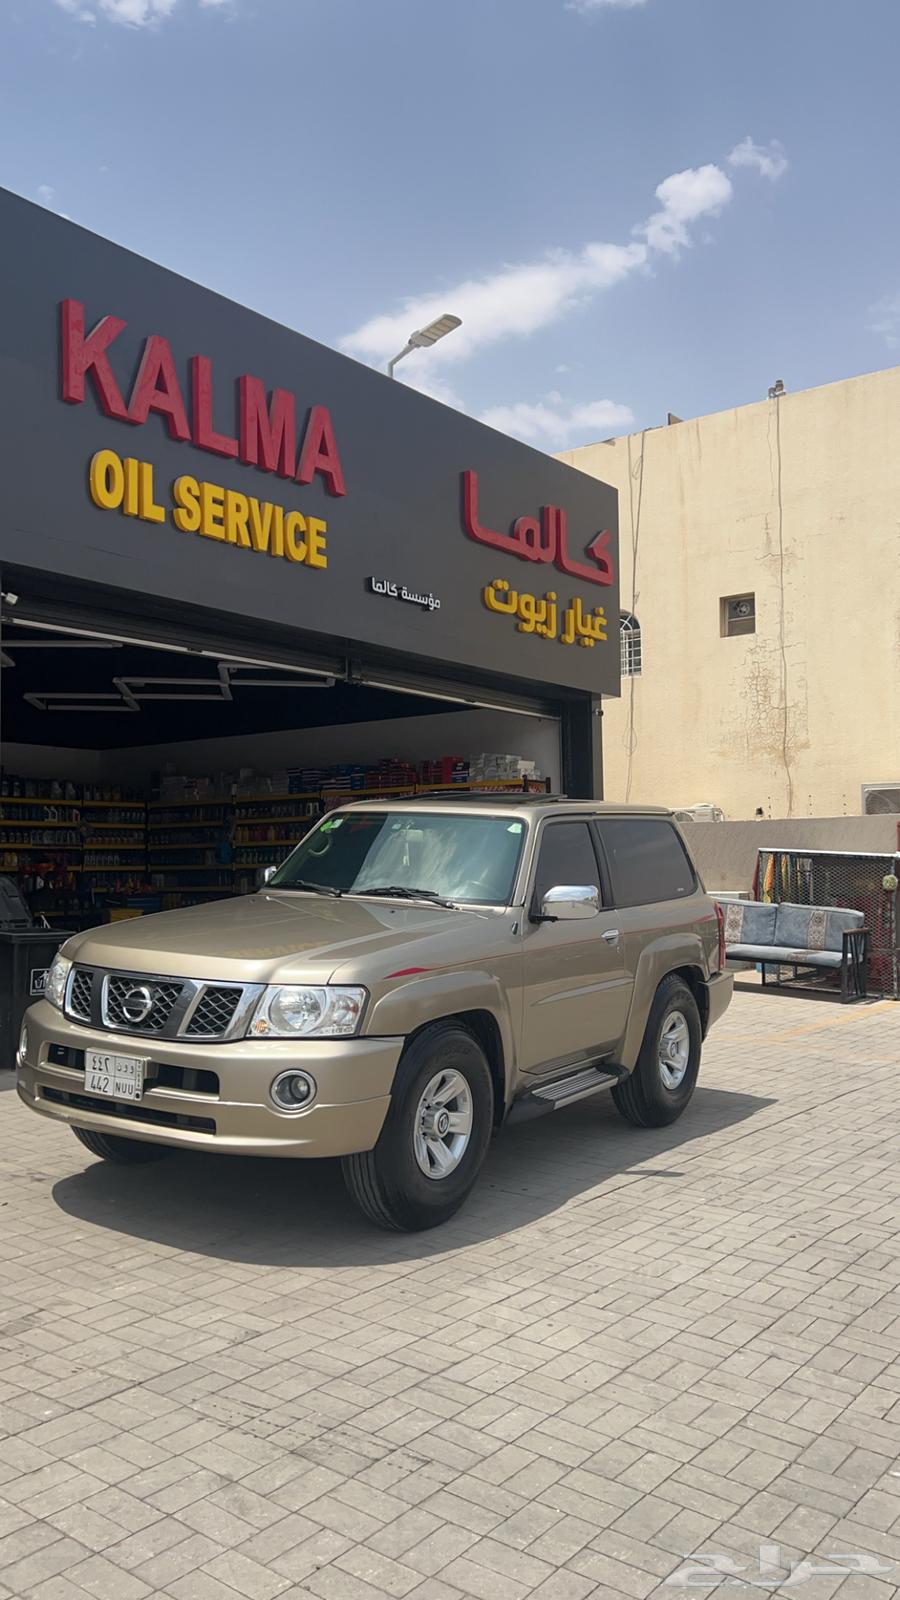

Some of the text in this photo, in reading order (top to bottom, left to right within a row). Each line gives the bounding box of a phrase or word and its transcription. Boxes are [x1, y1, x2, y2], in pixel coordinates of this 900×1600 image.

[62, 299, 347, 496] KALMA
[90, 449, 327, 569] OIL SERVICE
[463, 469, 614, 586] كالما
[371, 576, 441, 610] مؤسسة كالما
[484, 578, 608, 647] غيار زيوت
[90, 1075, 134, 1095] 442 NUU
